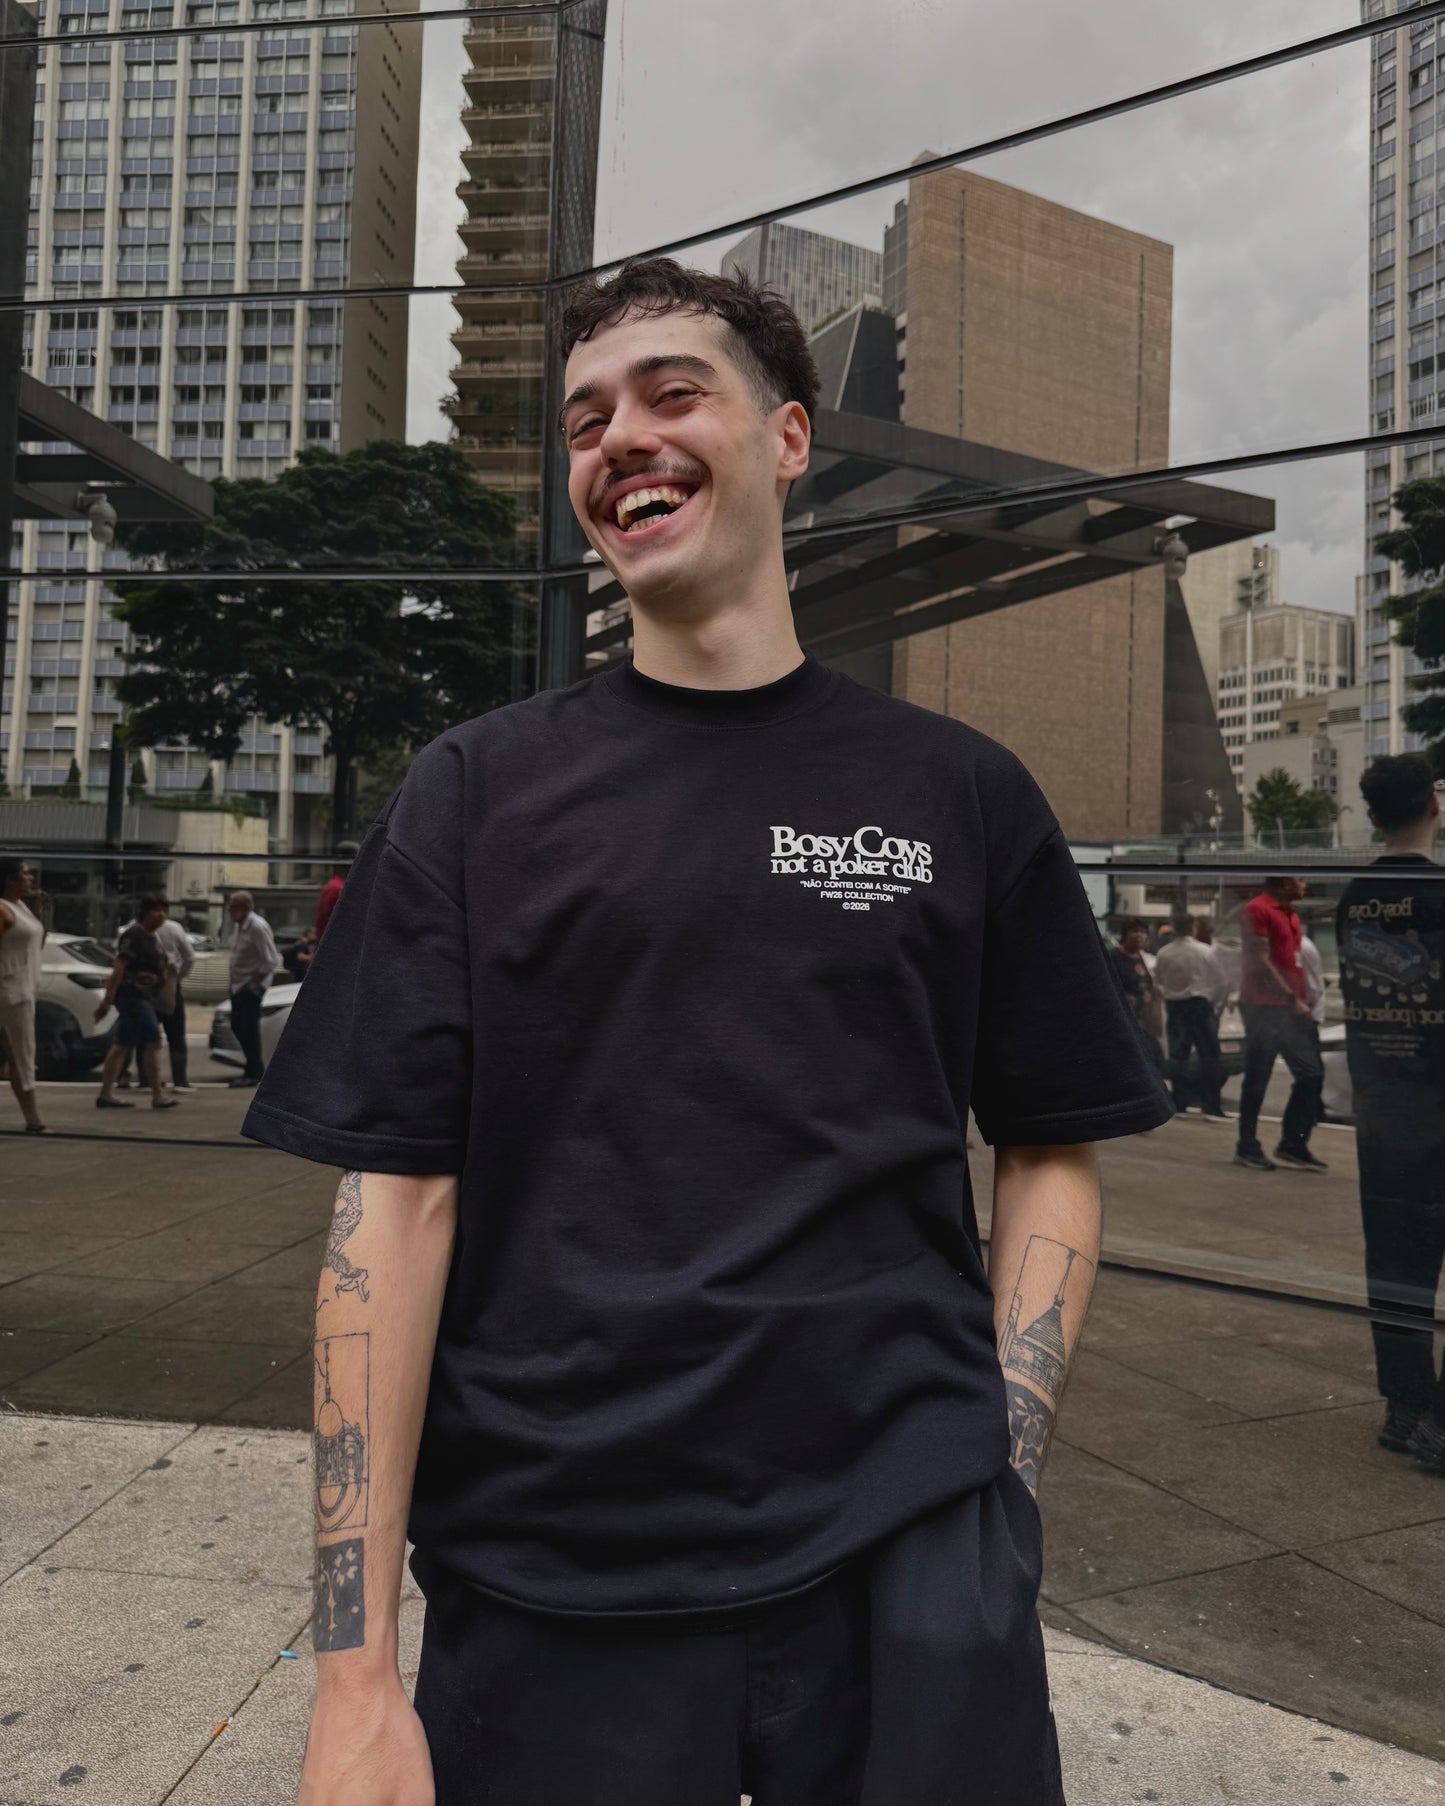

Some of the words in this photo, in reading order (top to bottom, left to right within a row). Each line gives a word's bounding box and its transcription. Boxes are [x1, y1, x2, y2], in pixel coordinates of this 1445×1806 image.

[769, 826, 853, 866] Bosy
[853, 826, 933, 867] Coys
[770, 856, 808, 874] not
[812, 858, 828, 874] a
[828, 853, 890, 880] poker
[892, 856, 933, 884] club
[823, 880, 854, 889] CONTEI
[854, 882, 874, 890] COM
[875, 882, 882, 891] A
[820, 891, 843, 899] FW26
[844, 891, 894, 903] COLLECTION
